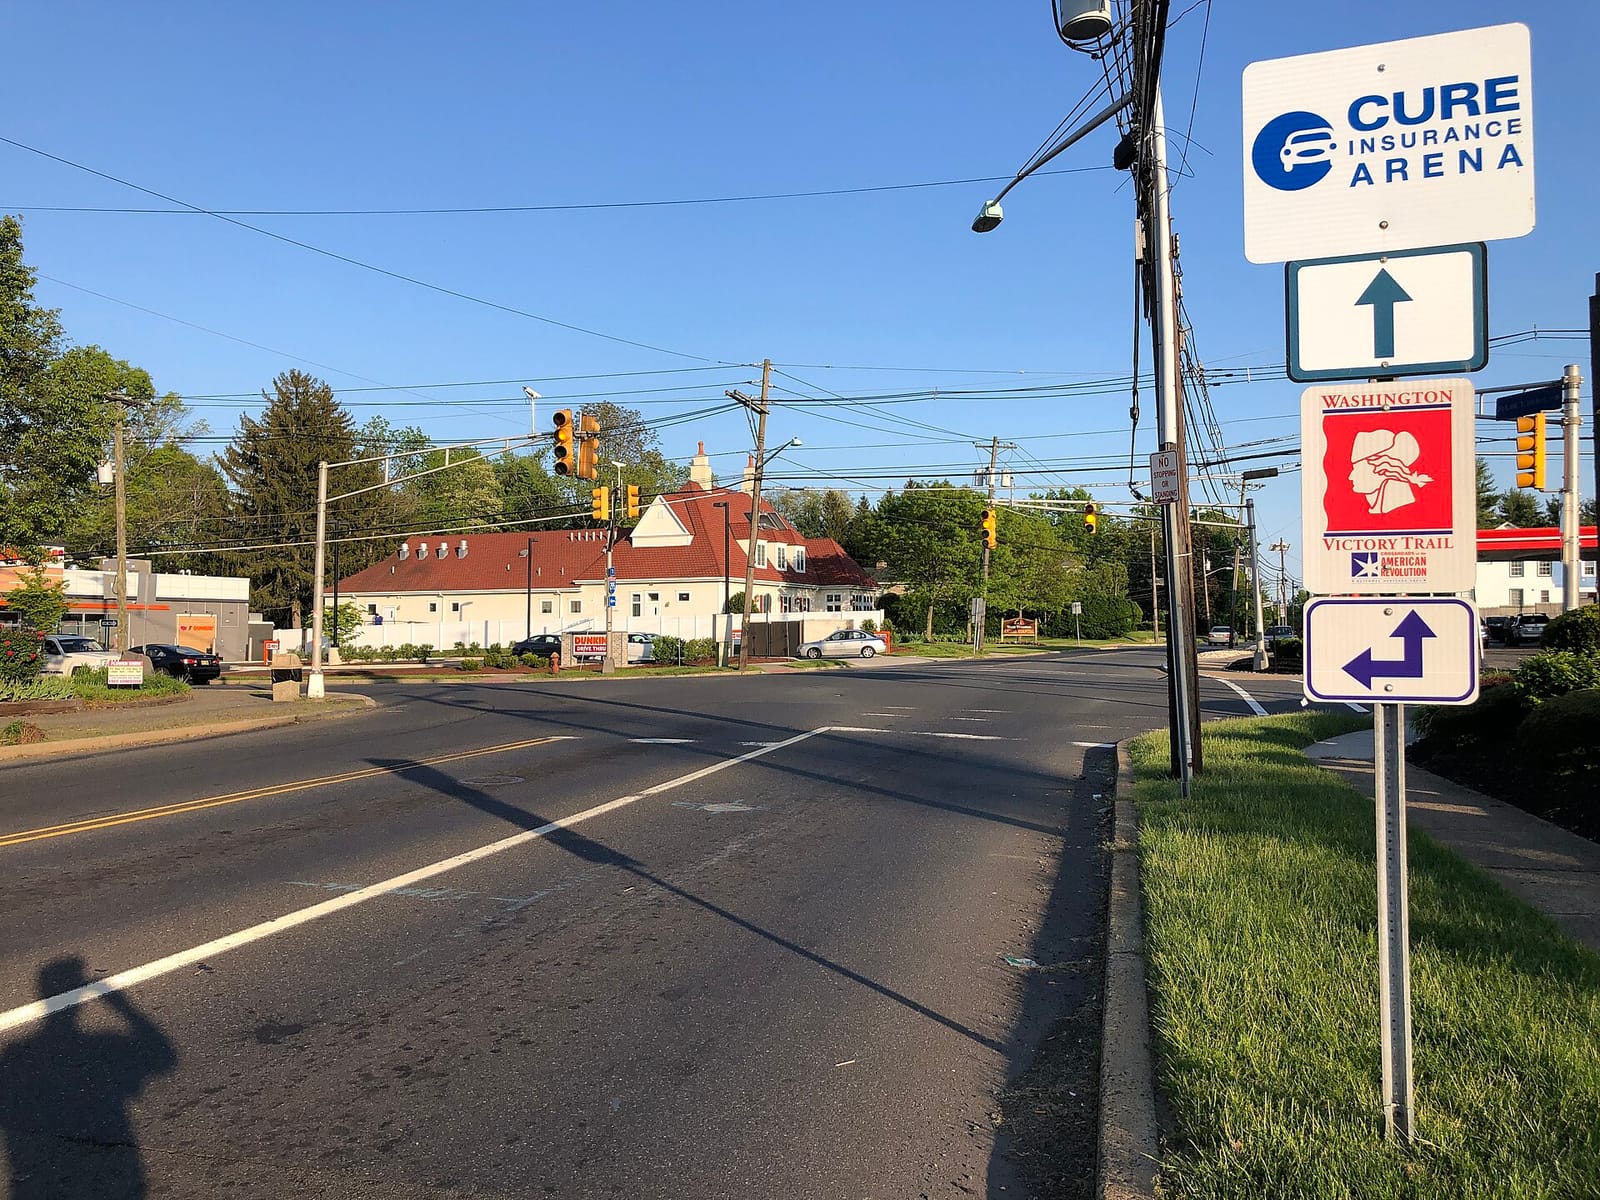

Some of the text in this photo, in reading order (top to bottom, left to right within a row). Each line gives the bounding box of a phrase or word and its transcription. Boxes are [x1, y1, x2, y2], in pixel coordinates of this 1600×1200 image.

[1347, 75, 1520, 132] CURE
[1348, 118, 1522, 155] INSURANCE
[1349, 143, 1523, 187] ARENA
[1321, 390, 1453, 408] WASHINGTON
[1158, 458, 1169, 467] NO
[1153, 470, 1176, 478] STOPPING
[1154, 490, 1177, 498] STANDING
[1322, 536, 1454, 551] VICTORY TRAIL
[1380, 556, 1427, 567] AMERICAN
[1380, 567, 1427, 577] REVOLUTION
